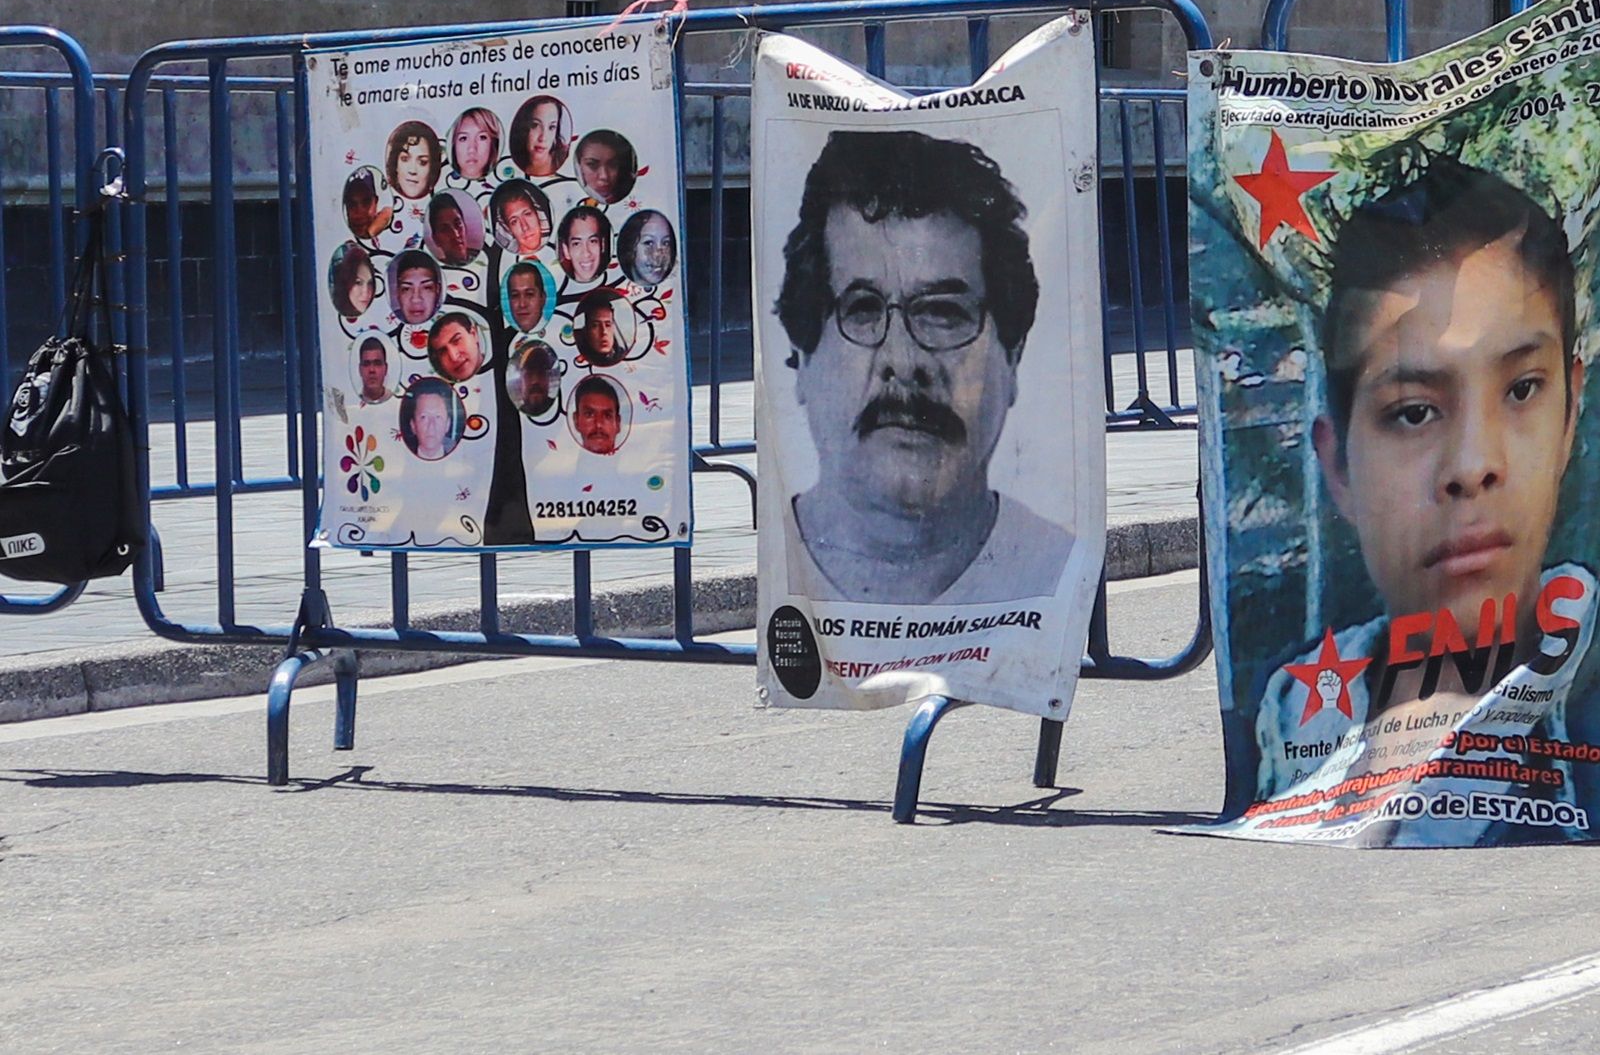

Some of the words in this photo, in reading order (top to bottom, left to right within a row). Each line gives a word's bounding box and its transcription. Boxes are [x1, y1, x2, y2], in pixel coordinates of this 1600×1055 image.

[331, 57, 348, 77] Te
[354, 58, 389, 75] ame
[395, 48, 453, 71] mucho
[460, 45, 505, 66] antes
[513, 39, 534, 60] de
[540, 35, 626, 57] conocerte
[626, 34, 642, 51] y
[357, 82, 410, 105] amaré
[416, 80, 463, 100] hasta
[470, 72, 485, 95] el
[491, 69, 530, 93] final
[538, 66, 560, 89] de
[567, 63, 598, 86] mis
[604, 60, 640, 83] días
[1221, 110, 1281, 126] Ejecutado
[1285, 107, 1439, 129] extrajudicialmente
[1444, 96, 1465, 111] 28
[1470, 83, 1491, 99] de
[1494, 53, 1557, 86] febrero
[1560, 43, 1579, 58] de
[1223, 70, 1368, 100] Humberto
[1372, 48, 1503, 102] Morales
[788, 92, 799, 108] 14
[800, 95, 814, 108] DE
[813, 94, 850, 112] MARZO
[945, 85, 1025, 109] OAXACA
[1505, 93, 1566, 126] 2004
[535, 499, 638, 519] 2281104252
[850, 616, 902, 639] RENÉ
[906, 615, 965, 639] ROMÁN
[967, 611, 1042, 633] SALAZAR
[914, 650, 945, 667] CON
[947, 647, 991, 663] VIDA!
[1284, 741, 1331, 760] Frente
[1385, 719, 1401, 734] de
[1406, 709, 1448, 731] Lucha
[1459, 731, 1500, 753] por
[1504, 734, 1523, 751] el
[1414, 759, 1562, 785] paramilitares
[1325, 804, 1344, 821] de
[1348, 799, 1371, 814] sus
[1431, 795, 1466, 815] de
